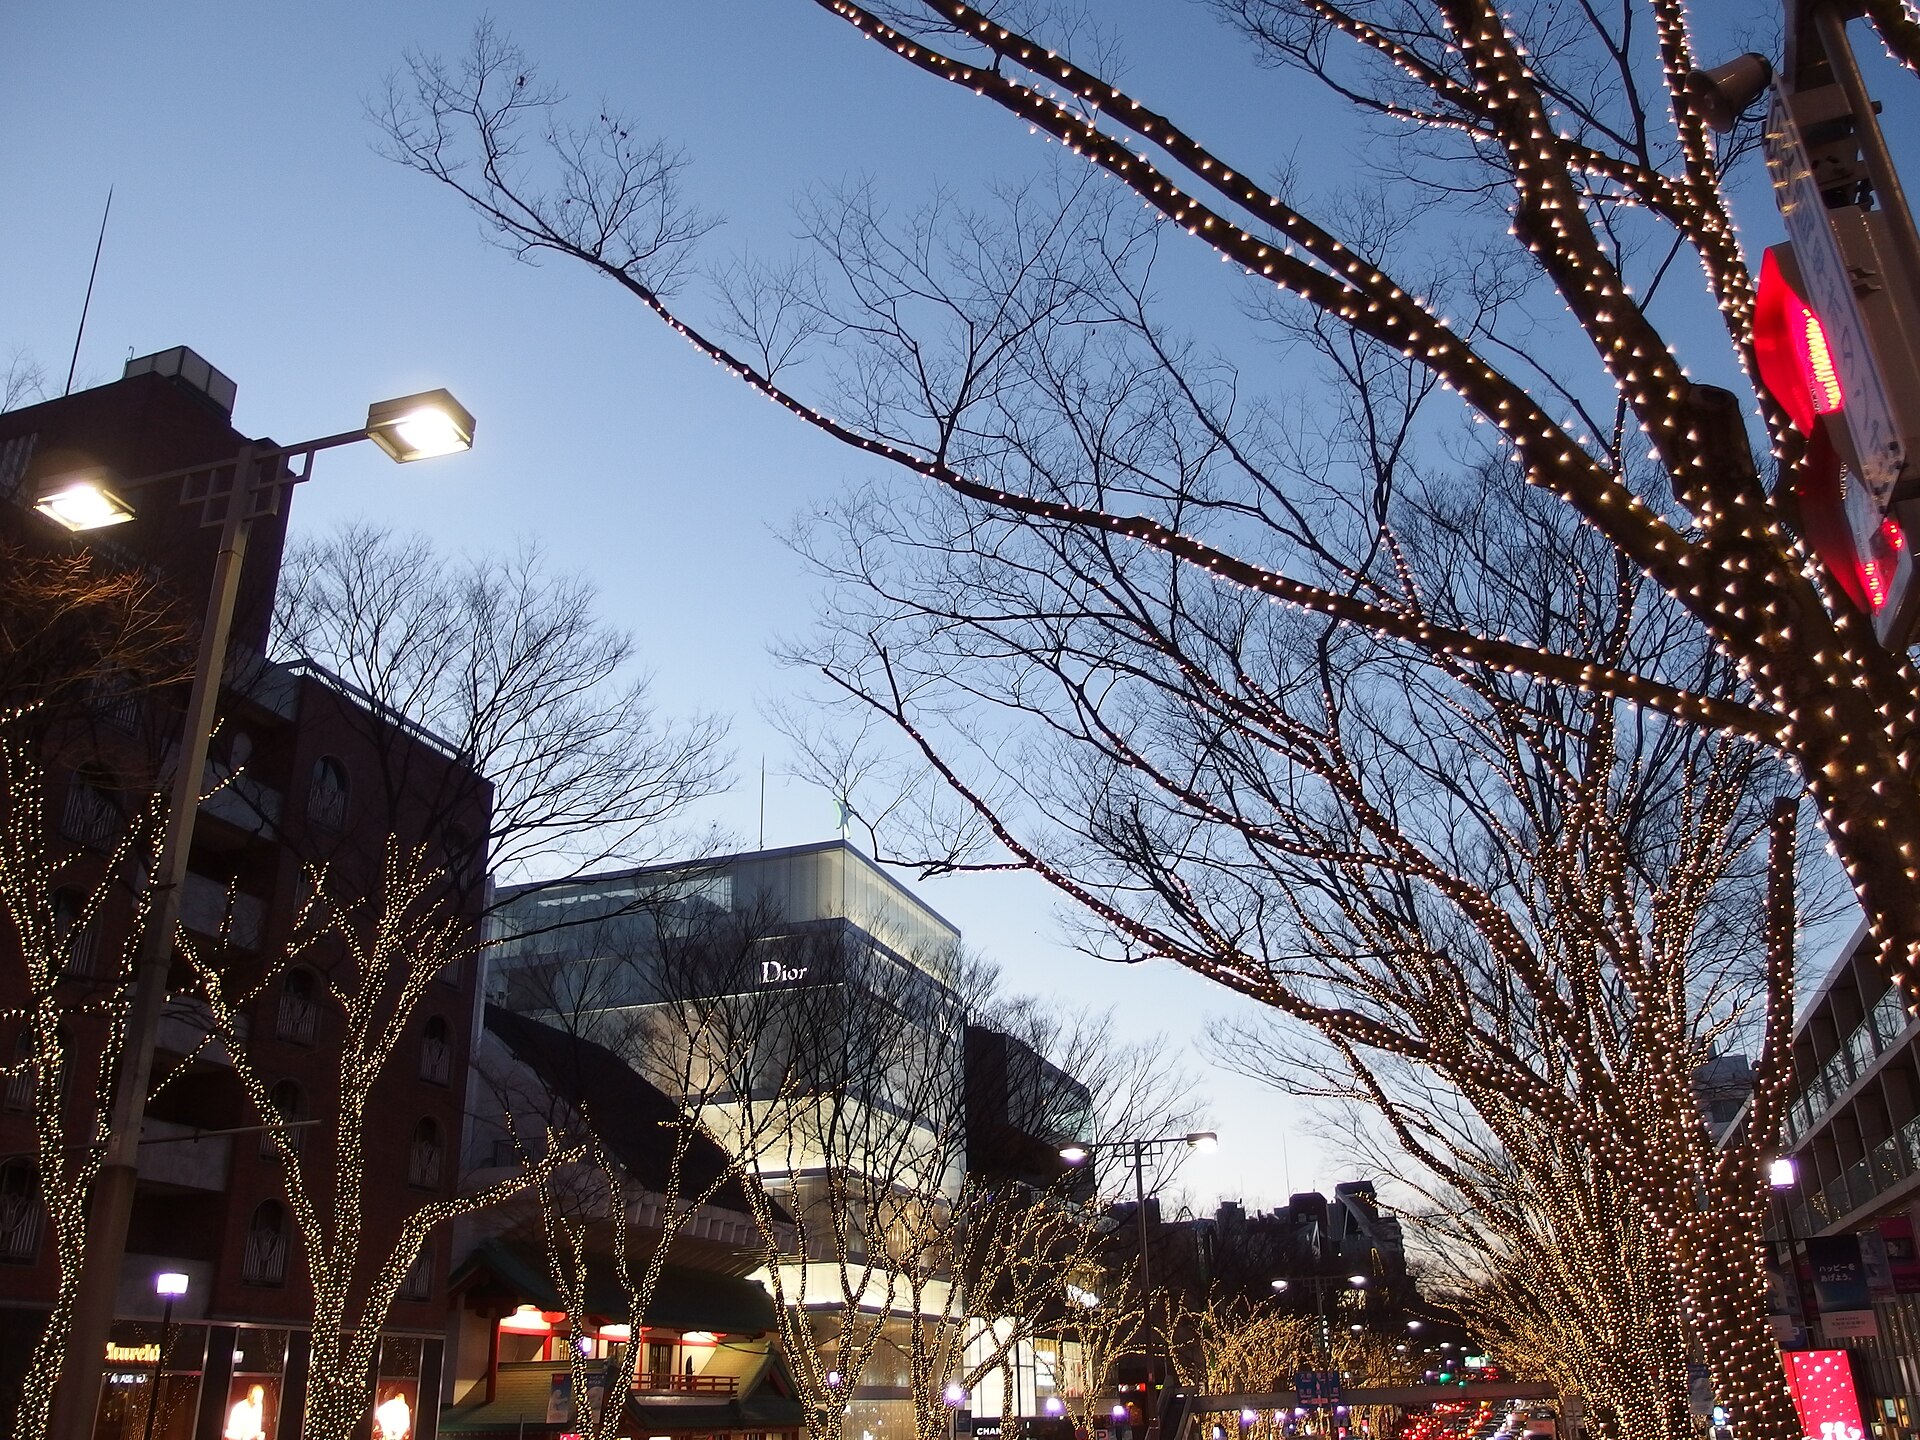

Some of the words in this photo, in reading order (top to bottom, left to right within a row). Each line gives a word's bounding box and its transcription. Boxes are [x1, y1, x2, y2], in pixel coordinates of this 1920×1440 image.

[761, 960, 808, 984] Dior
[1819, 1263, 1856, 1273] ハッピーを
[1820, 1273, 1852, 1282] あげよう。
